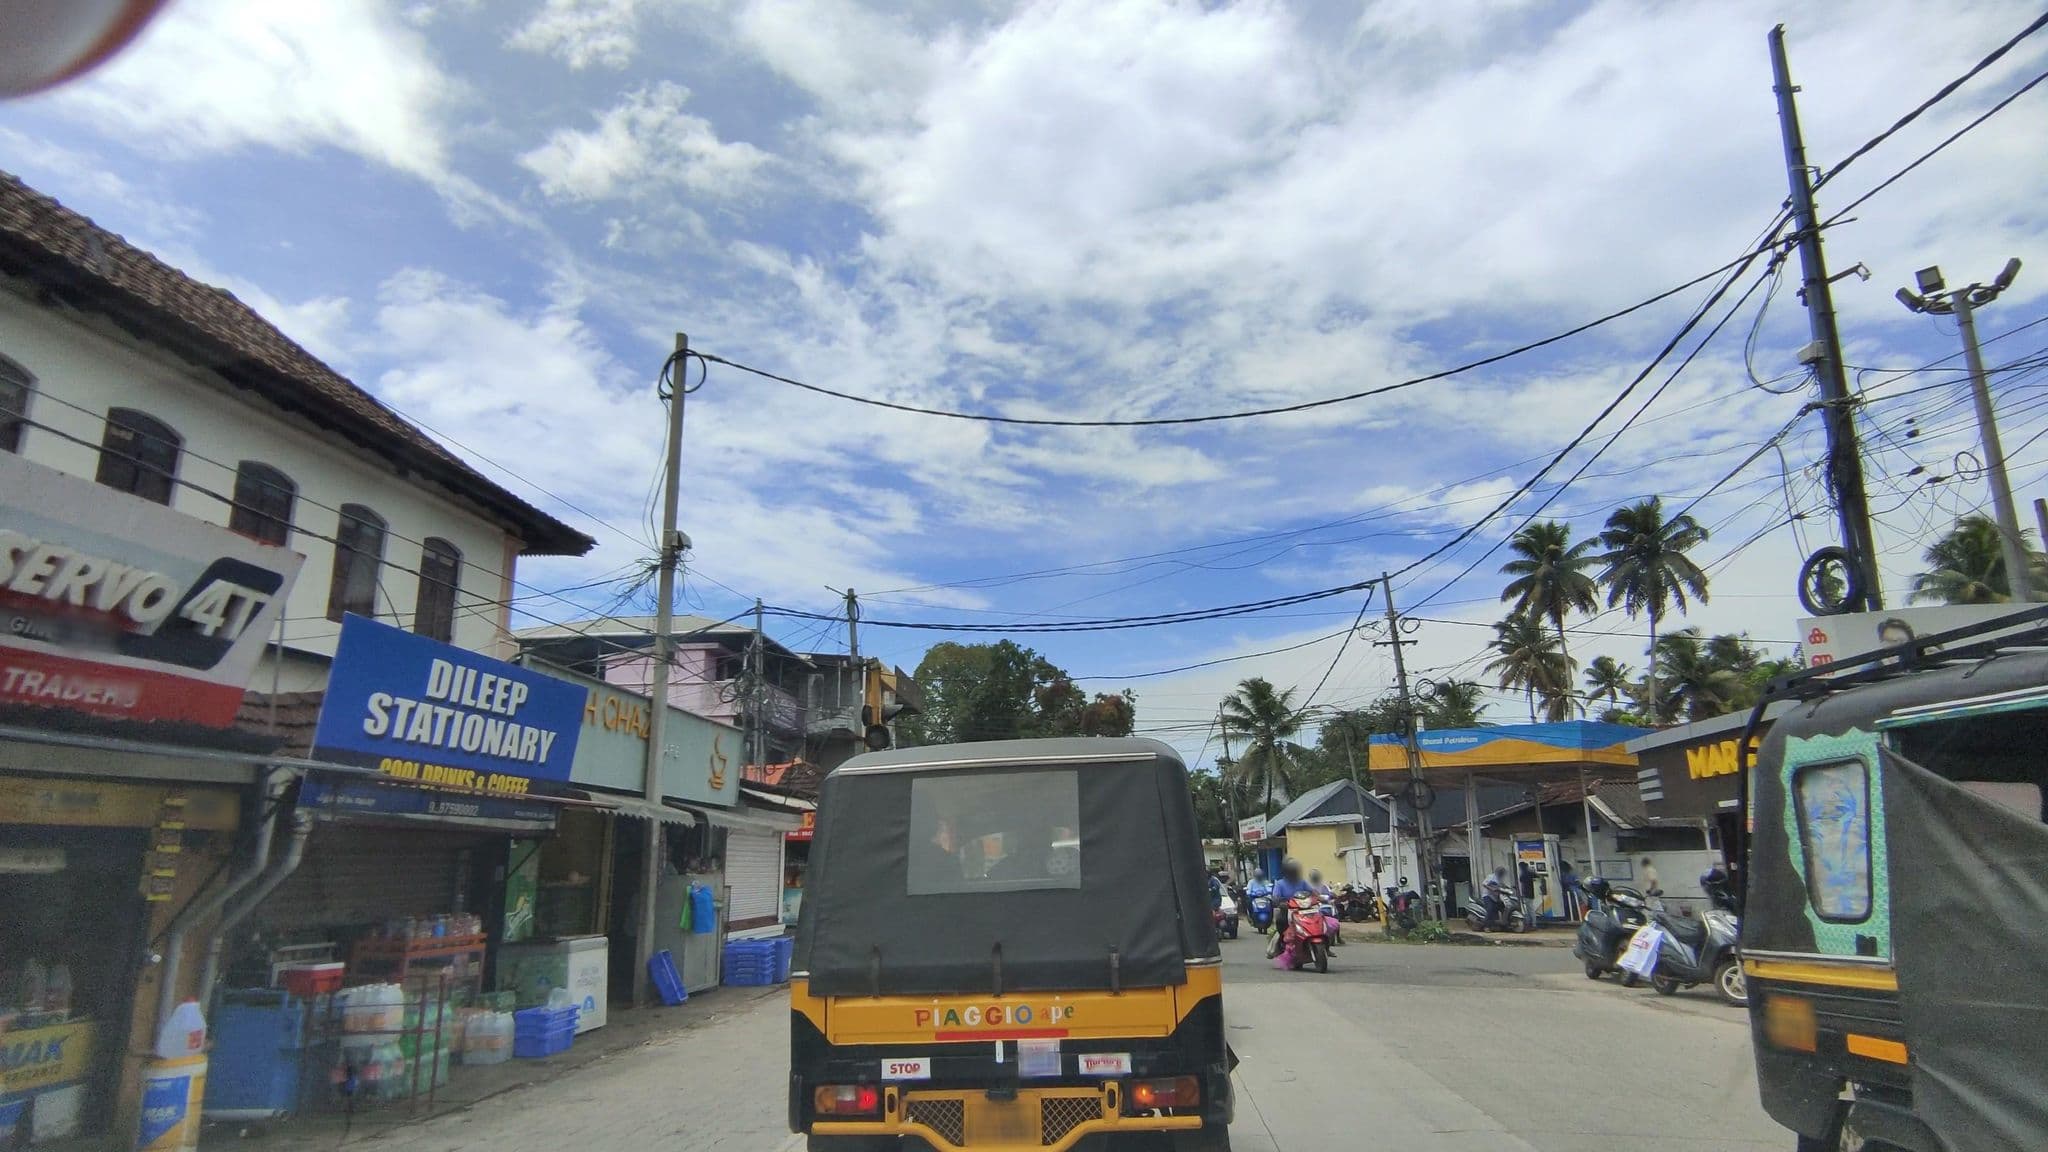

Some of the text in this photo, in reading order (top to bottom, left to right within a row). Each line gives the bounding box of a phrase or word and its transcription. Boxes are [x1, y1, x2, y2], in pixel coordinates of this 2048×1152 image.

[0, 529, 178, 624] SERVO
[425, 658, 529, 717] DILEEP
[363, 692, 557, 764] STATIONARY
[421, 764, 476, 794] DRINKS
[486, 772, 531, 799] COFFEE
[889, 1063, 922, 1075] STOP
